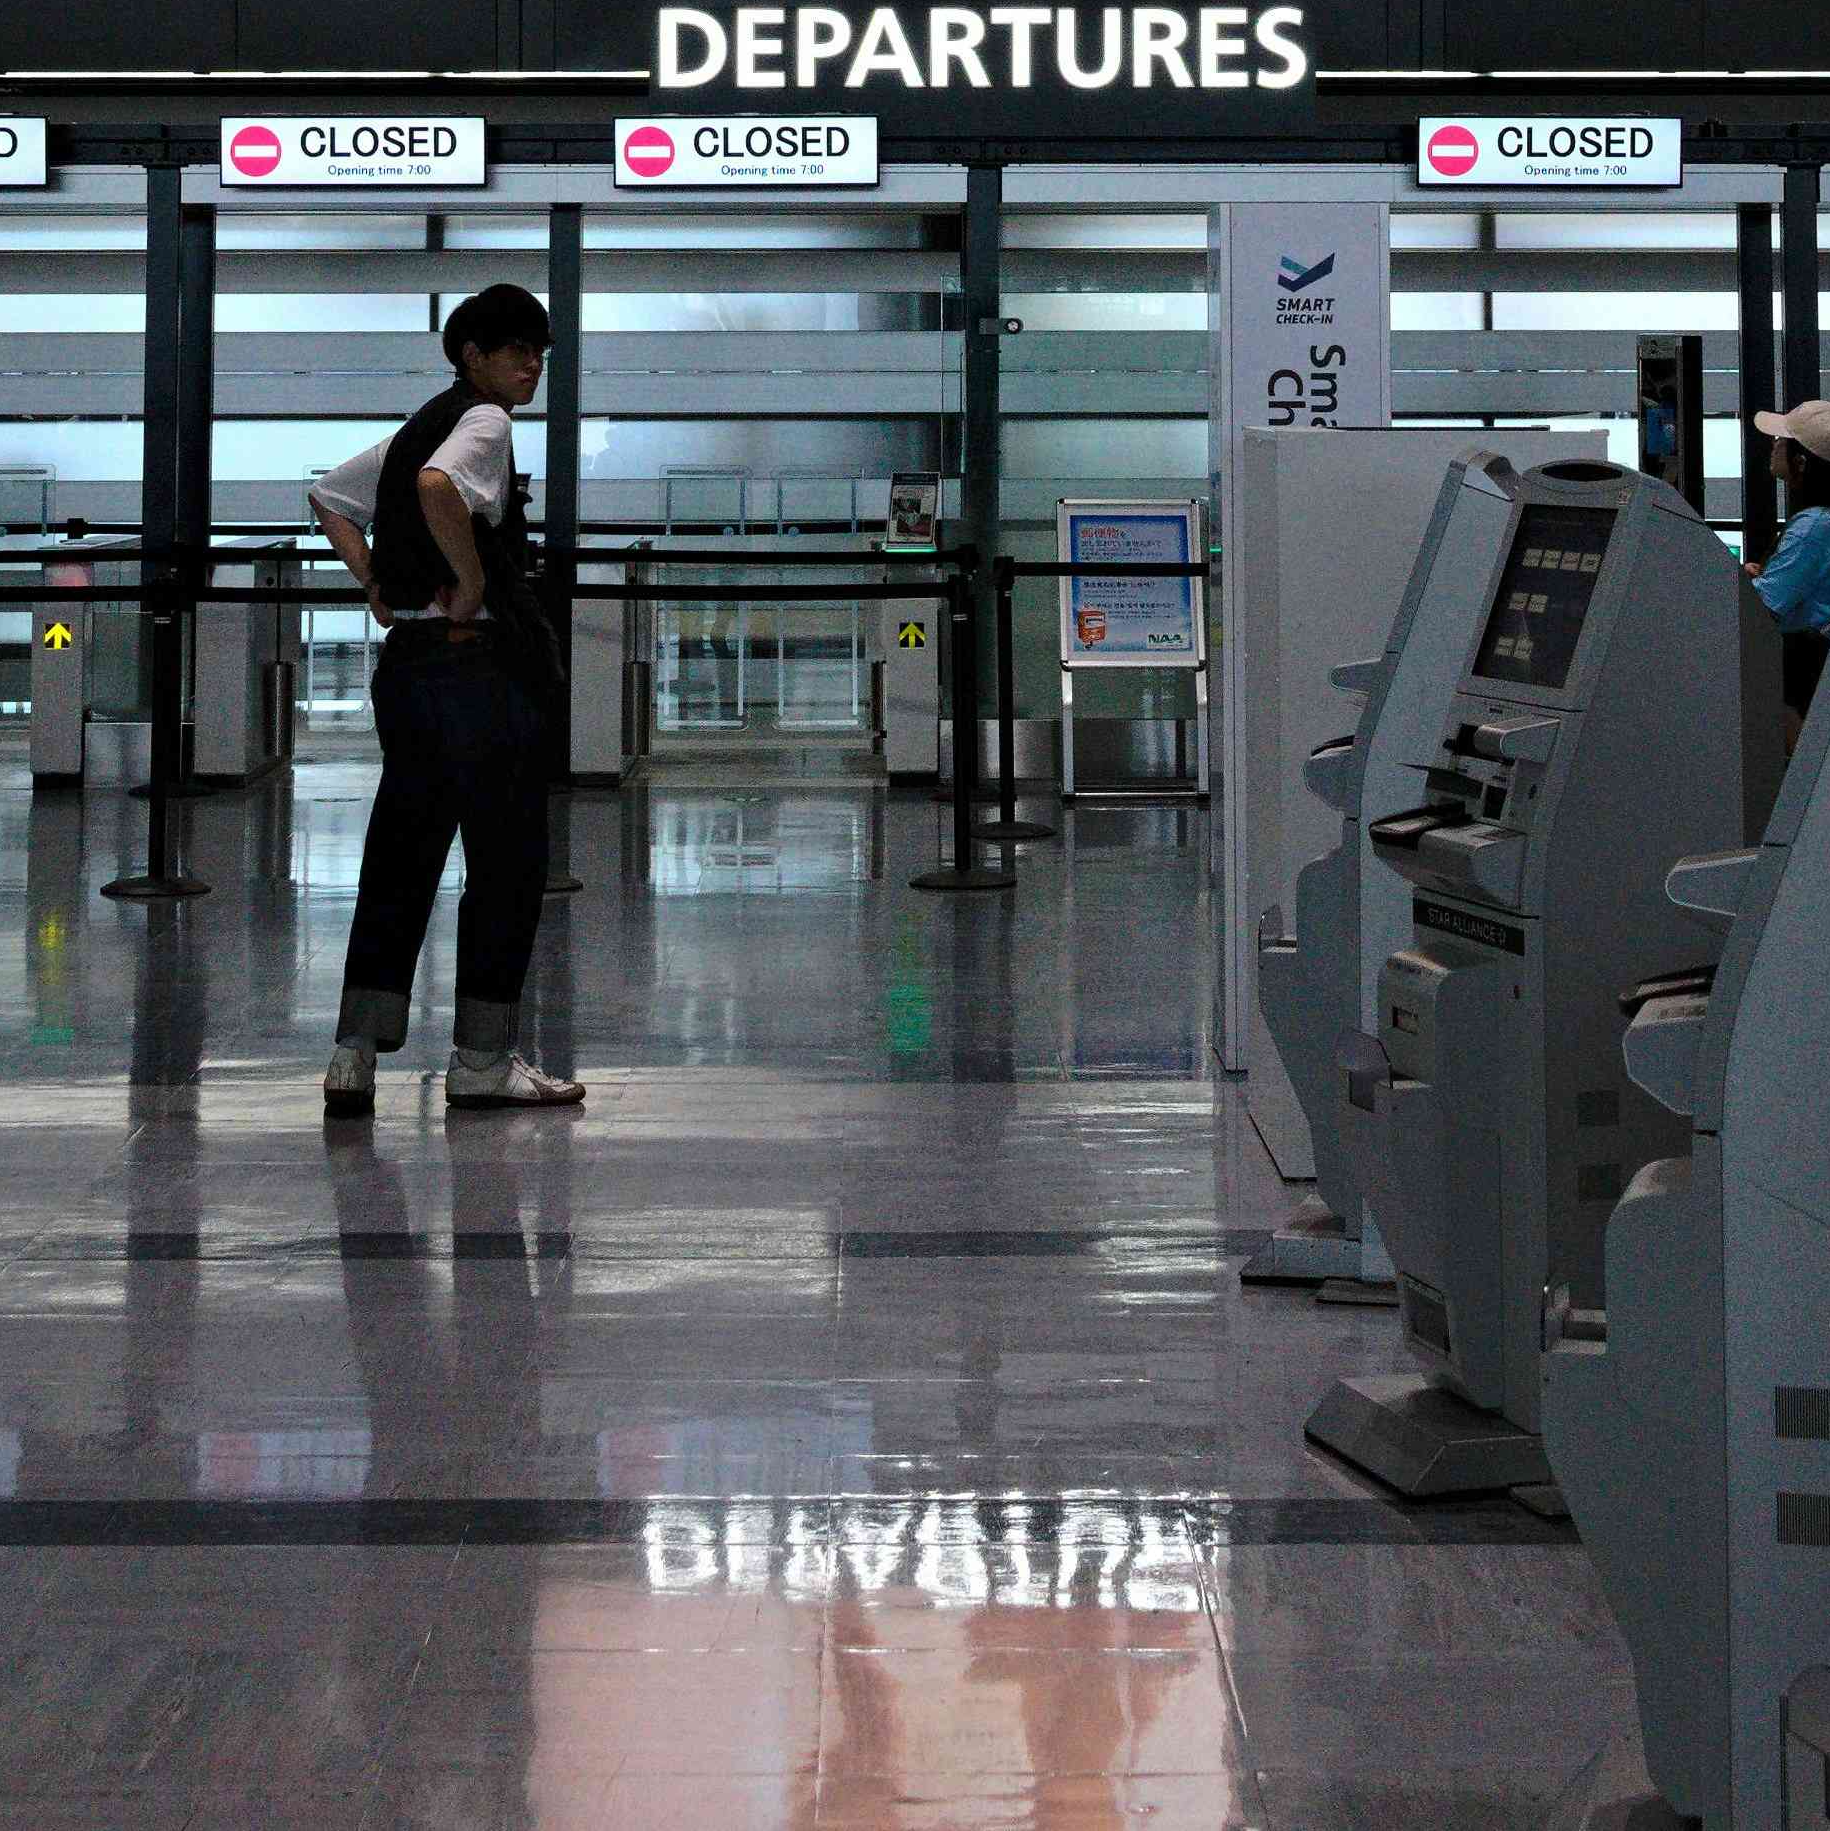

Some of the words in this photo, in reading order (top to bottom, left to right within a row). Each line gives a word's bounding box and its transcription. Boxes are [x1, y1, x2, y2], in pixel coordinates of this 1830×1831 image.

[658, 6, 1308, 90] DEPARTURES
[300, 126, 457, 158] CLOSED
[693, 126, 850, 158] CLOSED
[1497, 126, 1654, 159] CLOSED
[1276, 298, 1335, 312] SMART
[1276, 314, 1334, 324] CHECK-IN
[1427, 907, 1450, 928] STAR
[1451, 912, 1499, 941] ALLIANCE
